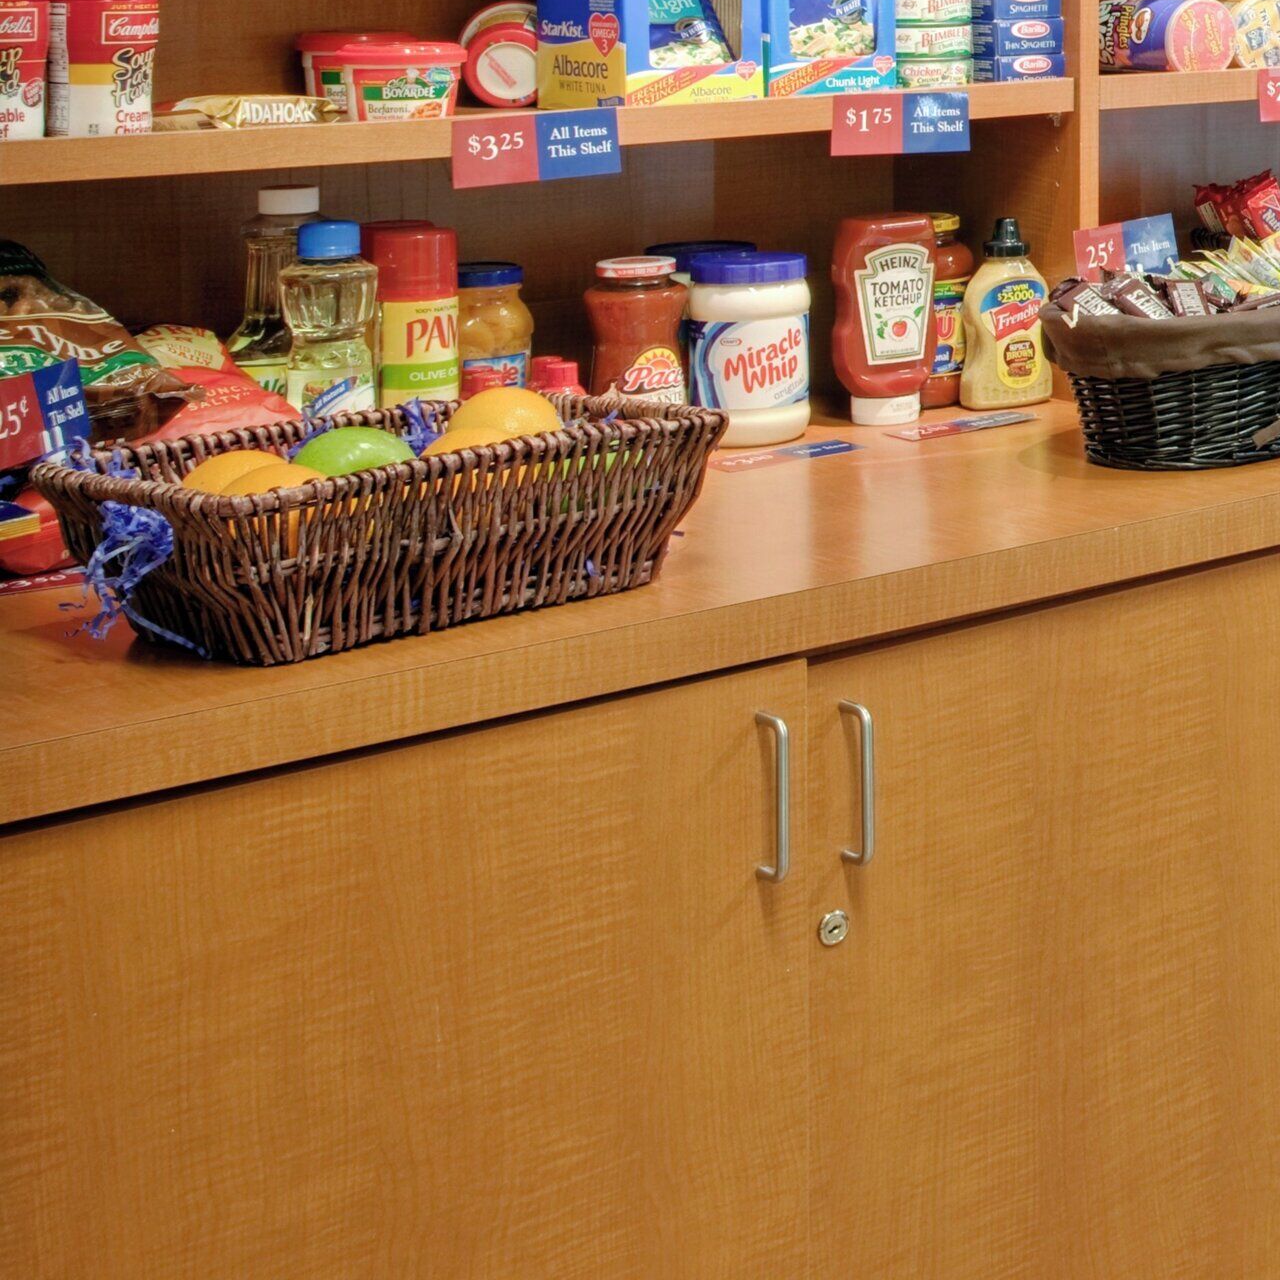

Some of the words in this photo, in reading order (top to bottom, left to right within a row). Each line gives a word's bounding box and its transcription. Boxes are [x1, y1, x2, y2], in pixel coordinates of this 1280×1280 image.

[1009, 3, 1049, 14] SPAGHETTI
[1004, 40, 1021, 50] THIN
[1020, 39, 1056, 50] SPAGHETTI
[552, 54, 609, 79] Albacore
[558, 80, 583, 91] WHITE
[585, 82, 607, 94] TUNA
[825, 76, 857, 88] Chunk
[857, 75, 881, 87] Light
[382, 86, 436, 100] BOYARDEE
[549, 127, 570, 141] All
[573, 125, 608, 139] Items
[910, 120, 935, 133] This
[937, 120, 964, 133] Shelf
[547, 143, 577, 158] This
[580, 140, 613, 155] Shelf
[1086, 238, 1116, 269] 25¢
[1130, 241, 1150, 256] This
[879, 255, 919, 272] HEINZ
[870, 277, 924, 296] TOMATO
[874, 292, 922, 309] KETCHUP
[997, 302, 1041, 331] French's
[723, 327, 802, 382] Miracle
[1005, 349, 1035, 360] BROWN
[408, 370, 447, 382] OLIVE
[742, 354, 799, 394] Whip
[773, 374, 806, 401] original
